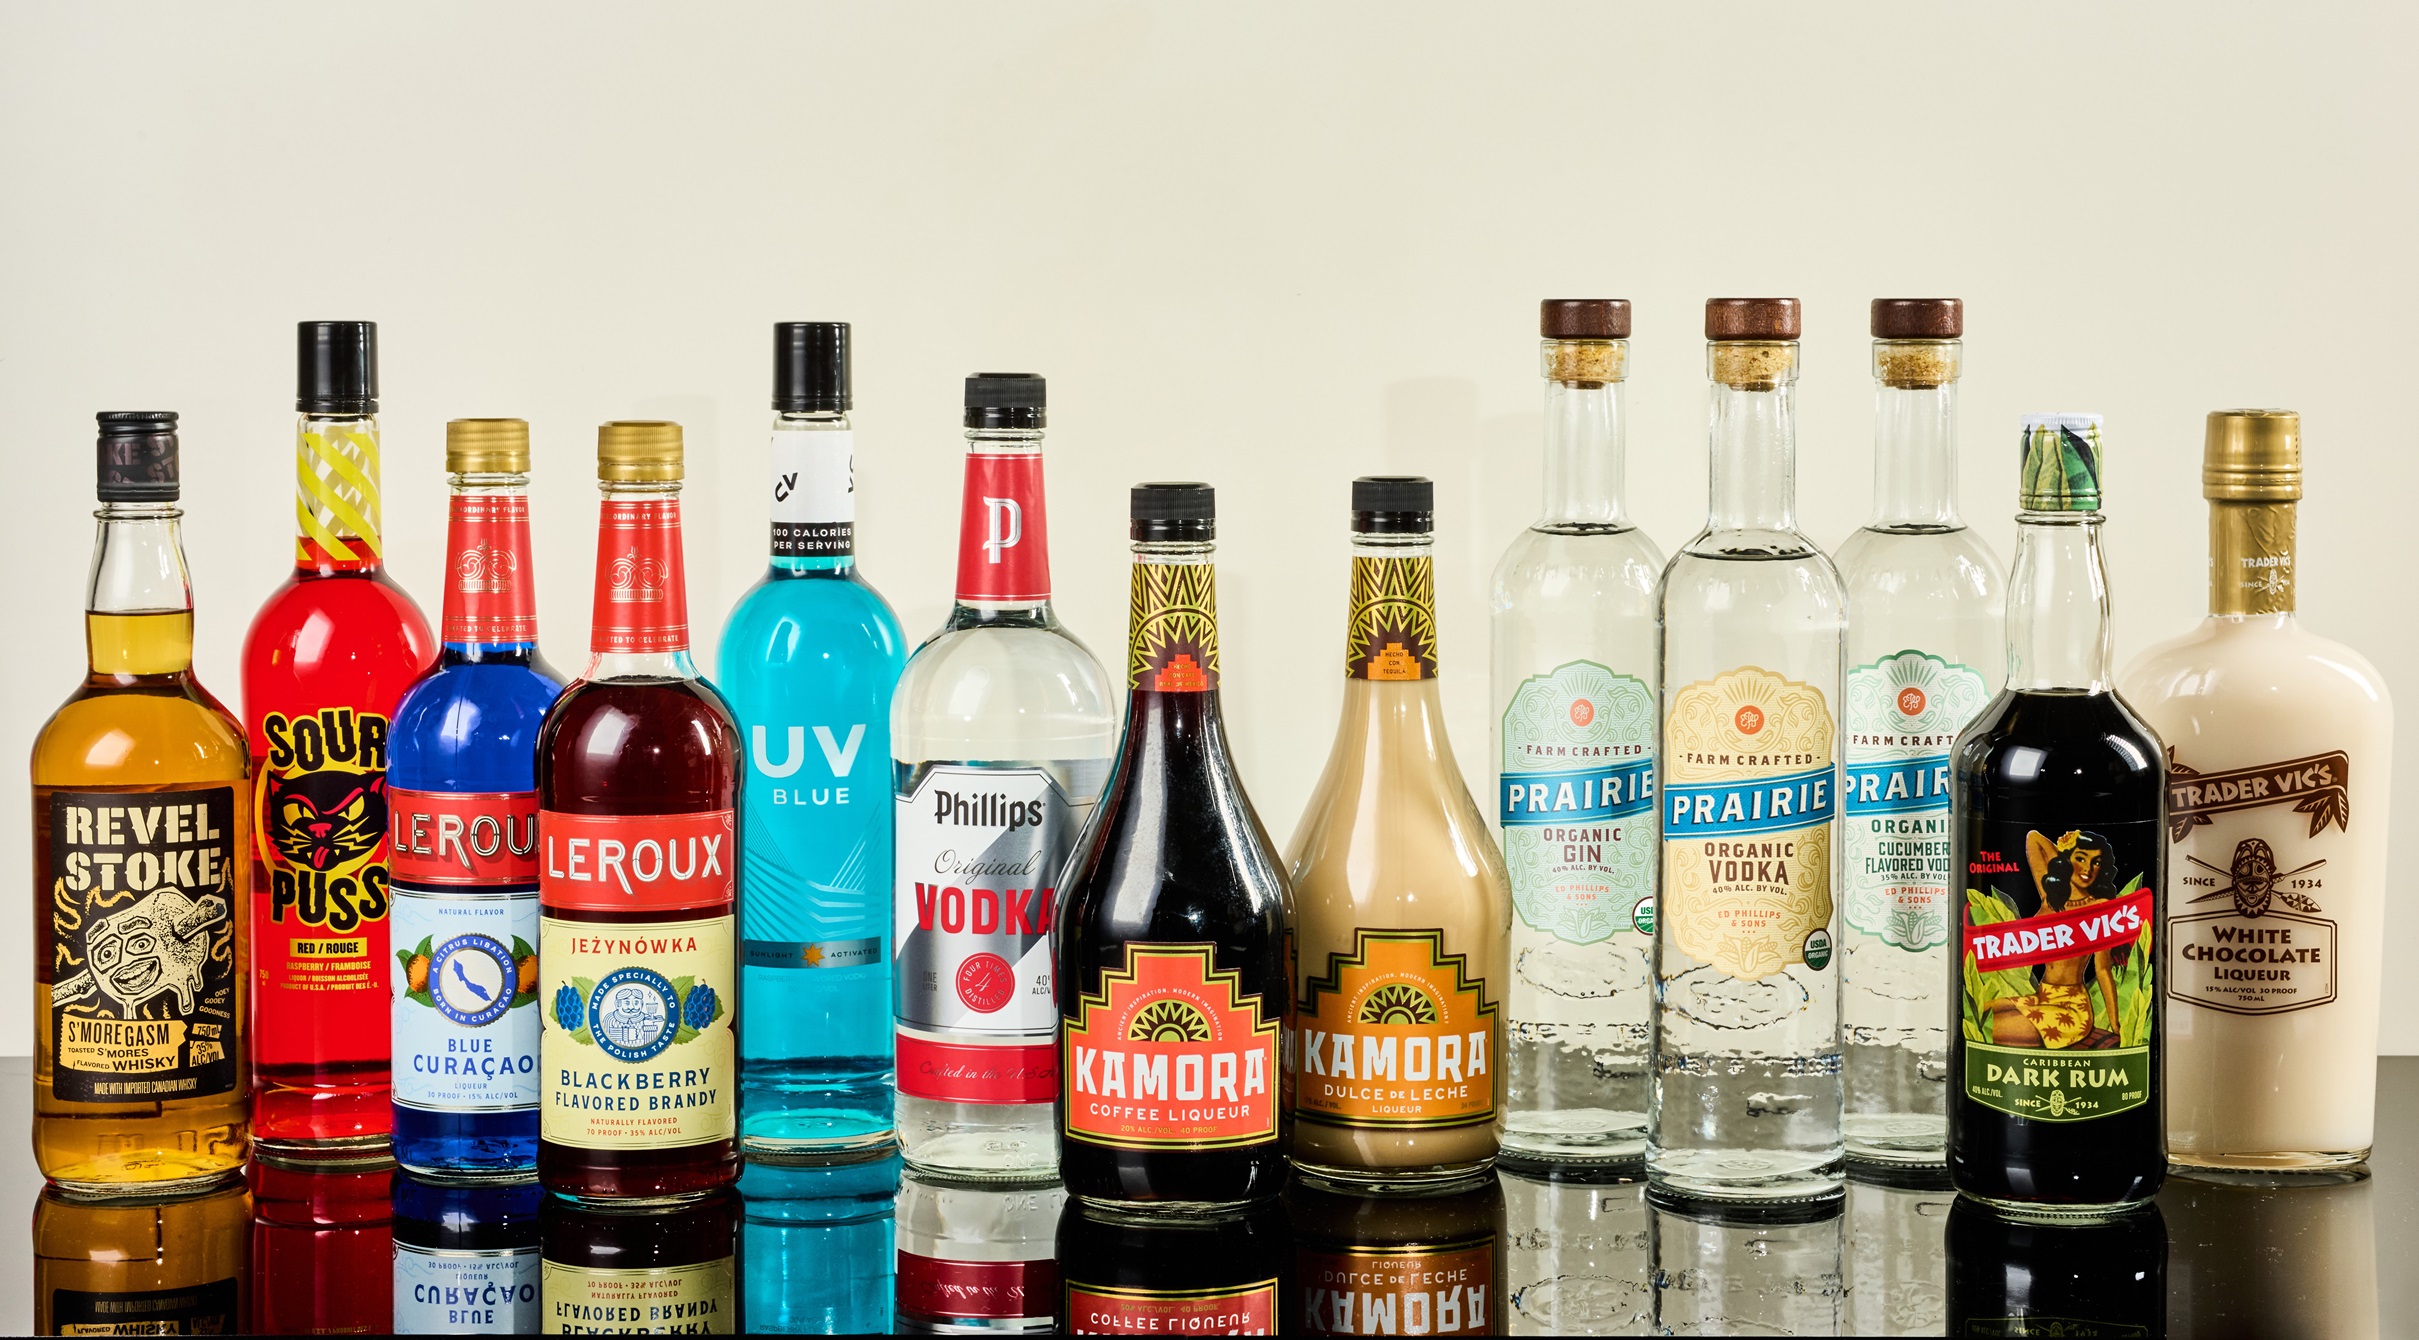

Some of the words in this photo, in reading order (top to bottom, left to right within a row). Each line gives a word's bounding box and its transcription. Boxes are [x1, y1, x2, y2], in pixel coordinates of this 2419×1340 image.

[772, 528, 788, 537] 100
[793, 527, 852, 537] CALORIES
[982, 496, 1022, 564] P
[773, 541, 793, 549] PER
[797, 541, 851, 550] SERVING
[2240, 556, 2279, 569] TRADER
[264, 707, 387, 772] SOUR
[1853, 734, 1894, 746] FARM
[752, 723, 867, 779] UV
[1526, 744, 1567, 756] FARM
[1572, 744, 1643, 756] CRAFTED
[1686, 752, 1730, 766] FARM
[1736, 752, 1813, 766] CRAFTED
[2171, 776, 2270, 808] TRADER
[2274, 763, 2333, 793] VIC'S
[772, 787, 850, 805] BLUE
[1672, 779, 1829, 825] PRAIRIE
[933, 789, 1044, 832] Phillips
[66, 803, 221, 845] REVEL
[394, 810, 540, 870] LEROU
[1543, 828, 1623, 842] ORGANIC
[1563, 844, 1602, 864] GIN
[1704, 842, 1794, 859] ORGANIC
[1878, 842, 1951, 857] CUCUMBER
[1979, 851, 2002, 863] THE
[65, 847, 222, 892] STOKE
[548, 833, 723, 895] LEROUX
[934, 849, 1042, 886] Original
[1552, 865, 1569, 873] 40%
[1600, 865, 1615, 874] VOL.
[1865, 857, 1924, 874] FLAVORED
[1969, 862, 2020, 875] ORIGINAL
[1708, 860, 1790, 886] VODKA
[1569, 885, 1610, 893] PHILLIPS
[1712, 885, 1732, 894] 40%
[1734, 884, 1753, 892] ALC.
[1769, 885, 1788, 896] VOL.
[2182, 876, 2216, 887] SINCE
[2290, 878, 2323, 889] 1934
[269, 863, 389, 932] PUSS
[1575, 893, 1597, 901] SONS
[1885, 887, 1897, 895] ED
[1901, 887, 1946, 896] PHILLIPS
[1907, 896, 1932, 904] SONS
[438, 908, 472, 916] NATURAL
[475, 908, 505, 916] FLAVOR
[1717, 911, 1730, 919] ED
[1734, 910, 1781, 919] PHILLIPS
[1741, 920, 1767, 928] SONS
[1972, 923, 2075, 961] TRADER
[2079, 904, 2141, 943] VIC'S
[2211, 925, 2292, 944] WHITE
[297, 942, 315, 954] RED
[326, 942, 359, 954] ROUGE
[571, 936, 698, 955] JEŻYNÓWKA
[1810, 938, 1827, 949] USDA
[436, 939, 468, 963] CITRUS
[473, 939, 513, 974] LIBATION
[750, 950, 793, 959] SUNLIGHT
[830, 947, 879, 958] ACTIVATED
[2181, 943, 2321, 964] CHOCOLATE
[286, 962, 324, 971] RASPBERRY
[331, 961, 372, 971] FRAMBOISE
[963, 961, 982, 982] FOUR
[922, 971, 937, 984] ONE
[2213, 967, 2291, 982] LIQUEUR
[591, 982, 610, 1010] MADE
[611, 972, 669, 993] SPECIALLY
[667, 995, 676, 1009] TO
[922, 984, 938, 992] LITER
[2222, 986, 2256, 994] ALC/VOL
[433, 988, 452, 1014] BORN
[455, 1013, 466, 1022] IN
[471, 988, 512, 1022] CURAÇAO
[1346, 996, 1359, 1024] ANCIENT
[1400, 972, 1427, 984] MODERN
[199, 1005, 231, 1019] GOODNESS
[1117, 1011, 1129, 1041] ANCIENT
[1172, 988, 1201, 1002] MODERN
[1200, 1000, 1223, 1041] IMAGINATION
[68, 1021, 170, 1047] S'MOREGASM
[592, 1023, 607, 1044] THE
[607, 1044, 648, 1059] POLISH
[651, 1022, 676, 1052] TASTE
[97, 1047, 149, 1059] S'MORES
[447, 1038, 493, 1053] BLUE
[1304, 1028, 1487, 1083] KAMORA
[2022, 1058, 2091, 1068] CARIBBEAN
[77, 1060, 110, 1070] FLAVORED
[112, 1056, 176, 1071] WHISKY
[413, 1054, 534, 1081] CURAÇAO
[561, 1066, 711, 1091] BLACKBERRY
[1075, 1045, 1265, 1103] KAMORA
[1986, 1063, 2061, 1088] DARK
[2069, 1067, 2130, 1089] RUM
[94, 1082, 109, 1094] MADE
[123, 1081, 151, 1095] IMPORTED
[485, 1091, 519, 1099] ALC/VOL
[1324, 1084, 1384, 1101] DULCE
[1390, 1090, 1405, 1099] DE
[1410, 1085, 1469, 1101] LECHE
[2128, 1090, 2143, 1100] PROOF
[555, 1091, 641, 1112] FLAVORED
[649, 1088, 717, 1112] BRANDY
[2014, 1098, 2041, 1108] SINCE
[2075, 1101, 2100, 1110] 1934
[1089, 1103, 1160, 1121] COFFEE
[1169, 1104, 1251, 1122] LIQUEUR
[1371, 1105, 1423, 1114] LIQUEUR
[590, 1118, 635, 1126] NATURALLY
[637, 1117, 679, 1126] FLAVORED
[648, 1127, 682, 1136] ALC/VOL
